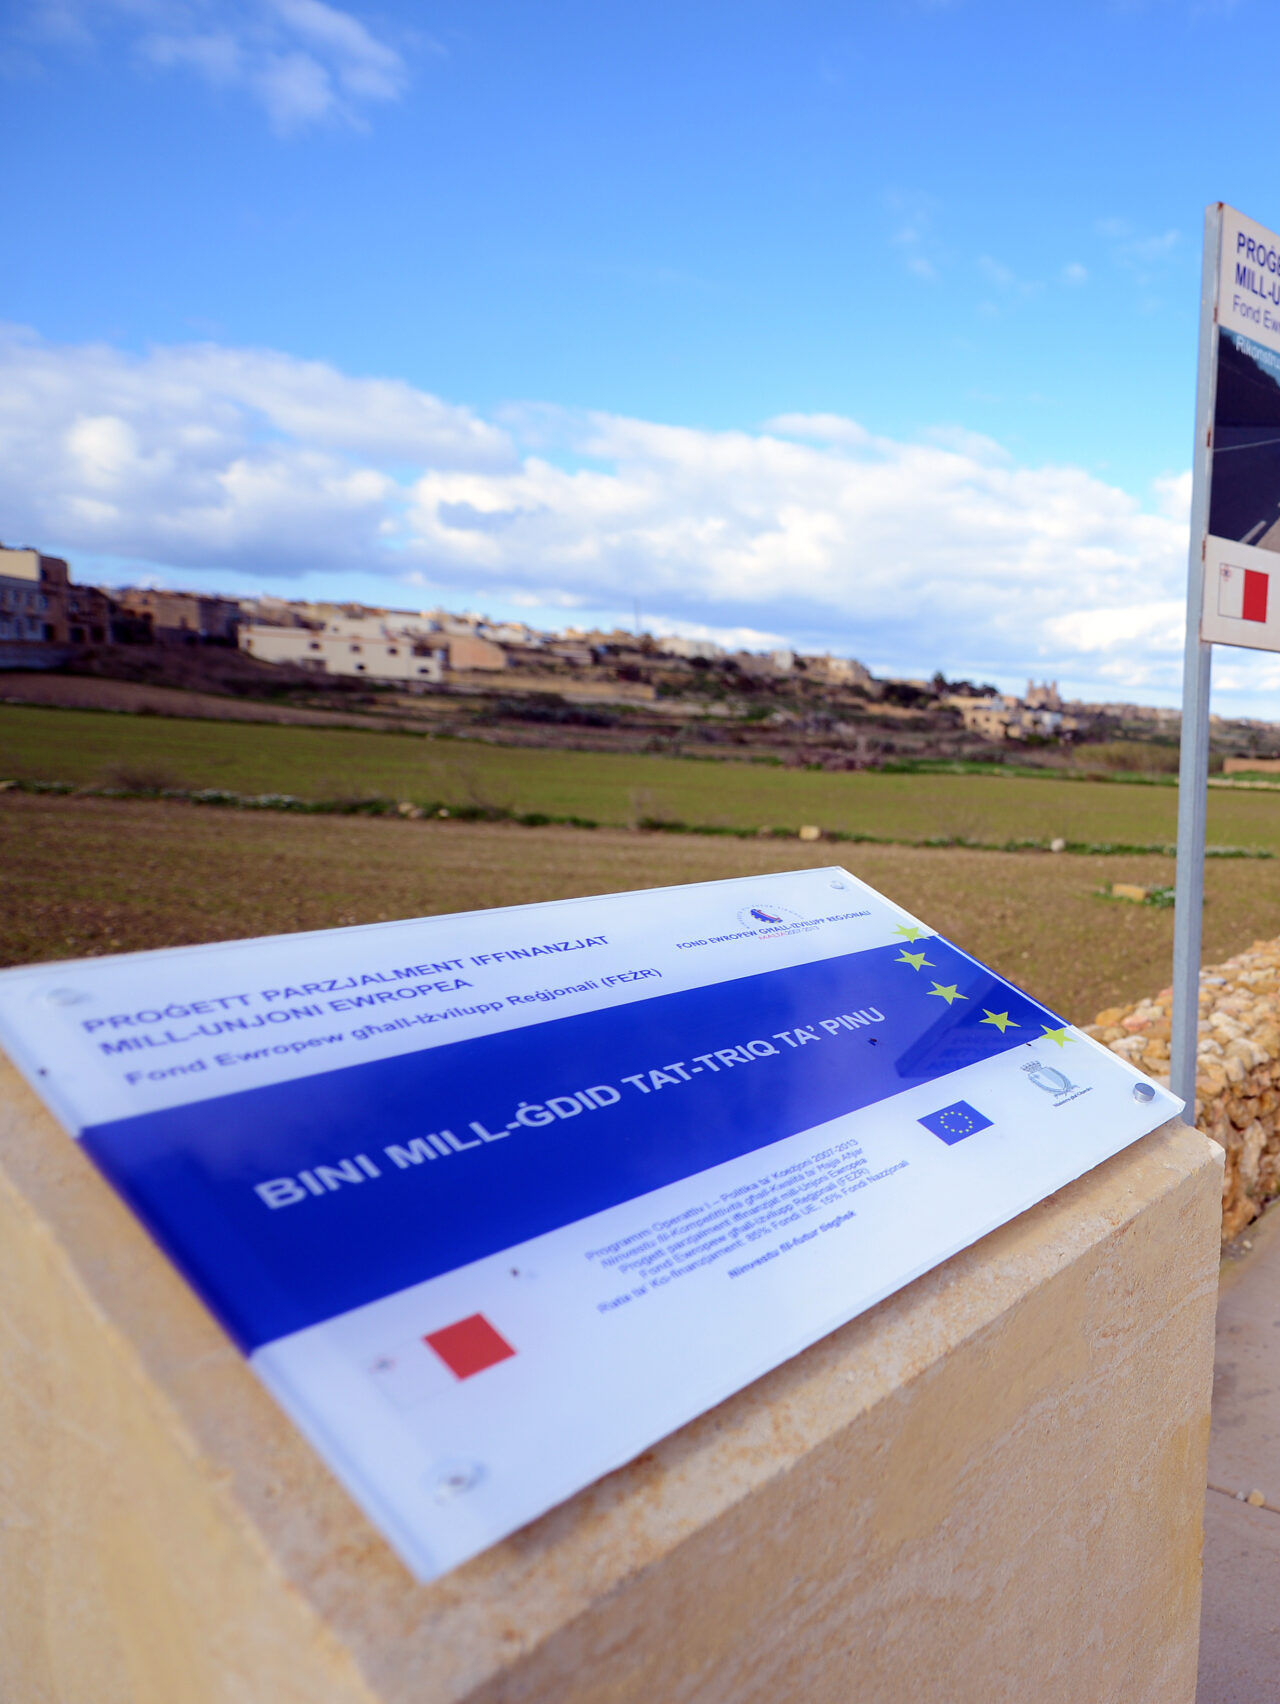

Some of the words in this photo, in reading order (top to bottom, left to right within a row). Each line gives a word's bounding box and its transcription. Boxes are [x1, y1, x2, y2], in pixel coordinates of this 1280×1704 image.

[1233, 294, 1261, 324] Fond
[676, 939, 708, 950] FOND
[708, 929, 758, 945] EWROPEW
[82, 994, 251, 1034] PROĠETT
[260, 958, 465, 1002] PARZJALMENT
[470, 935, 611, 966] IFFINANZJAT
[98, 1003, 325, 1057] MILL-UNJONI
[327, 978, 473, 1013] EWROPEA
[123, 1058, 207, 1086] Fond
[213, 1031, 345, 1067] Ewropew
[504, 979, 600, 1006] Reġjonali
[600, 967, 664, 988] (FEŻR)
[253, 1153, 382, 1211] BINI
[384, 1085, 622, 1170] MILL-ĠDID
[621, 1039, 780, 1094] TAT-TRIQ
[818, 1007, 886, 1036] PINU
[811, 1138, 859, 1162] 2007-2013
